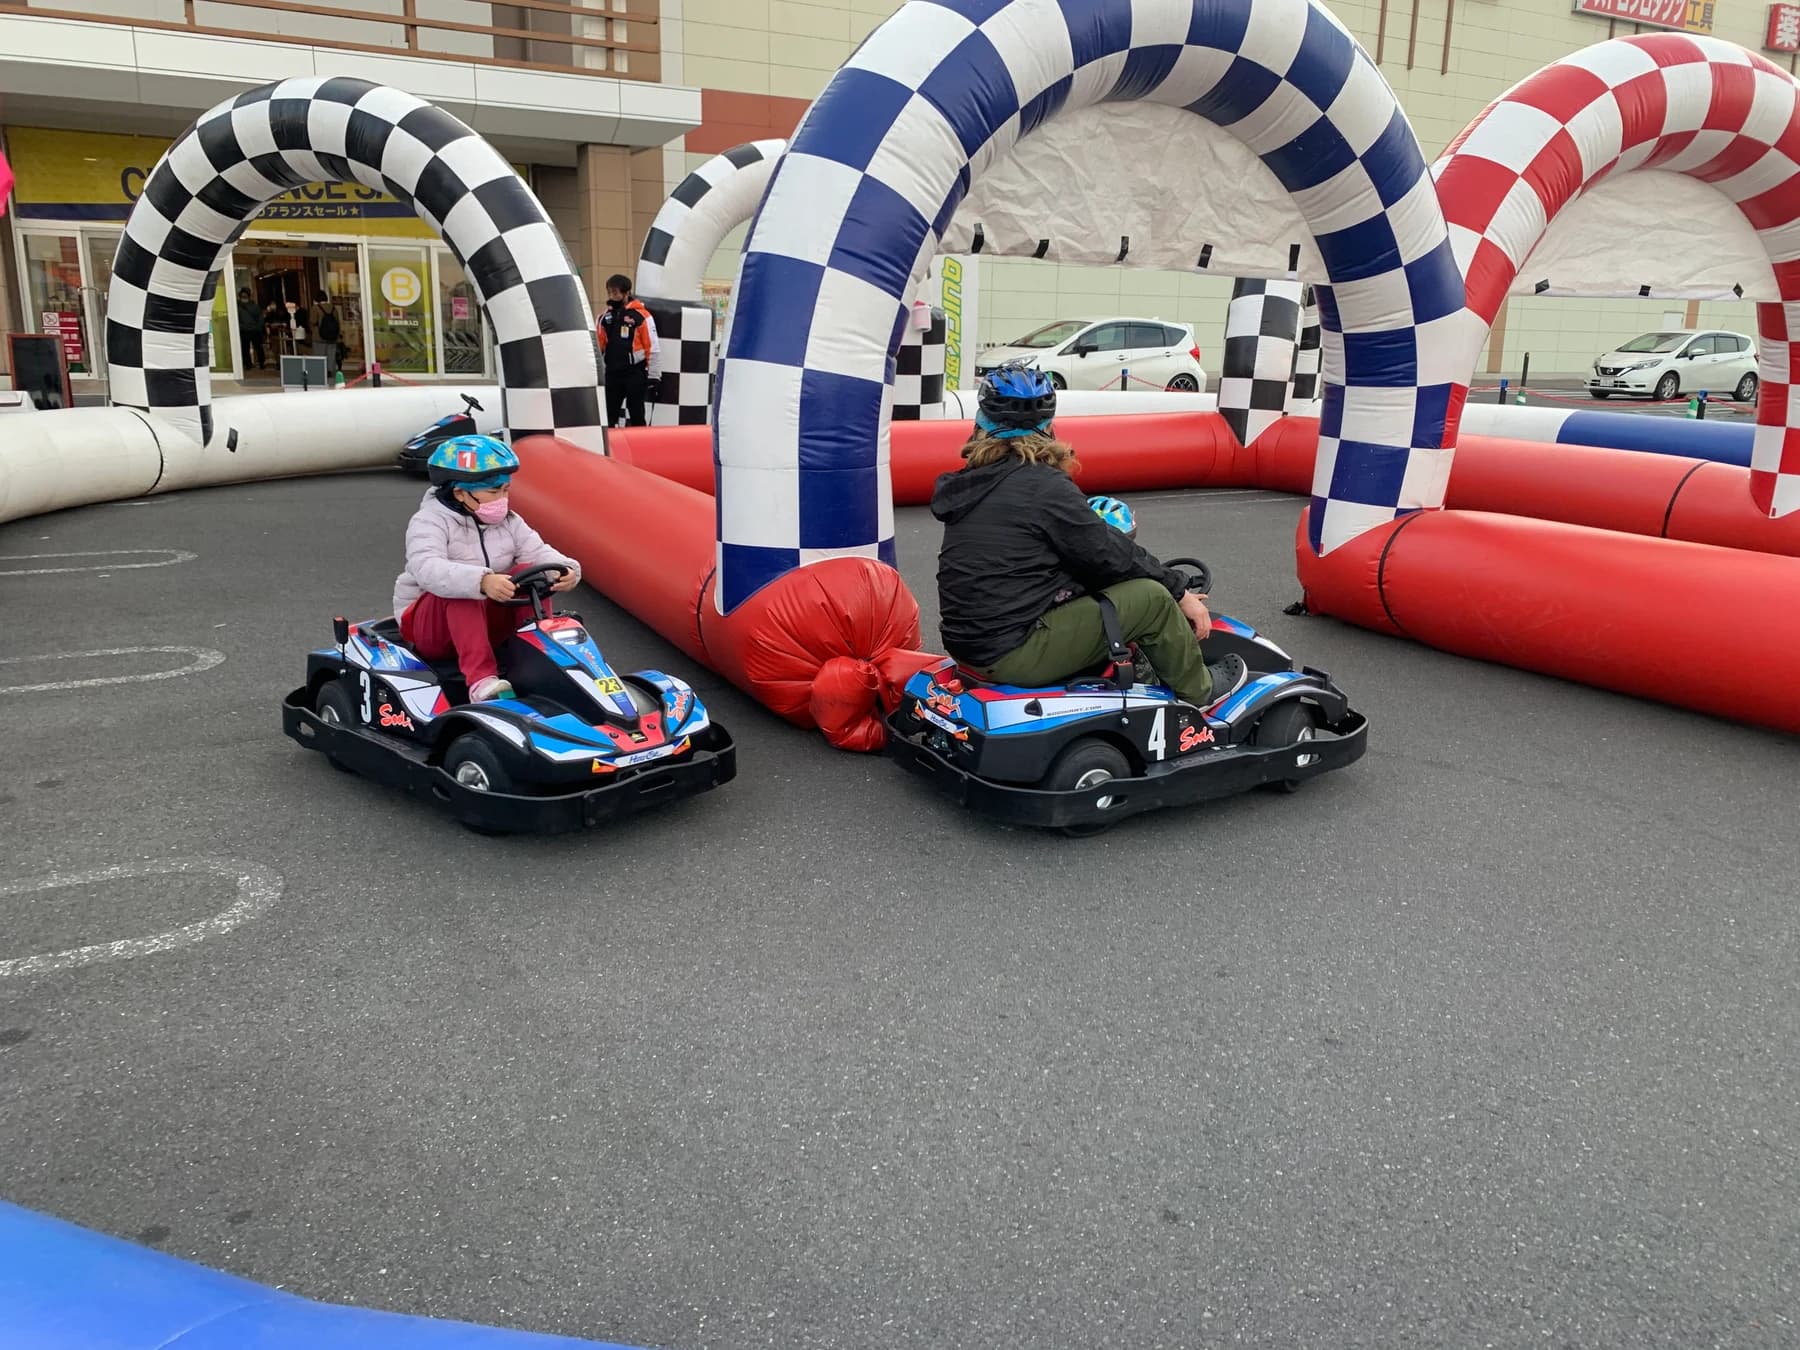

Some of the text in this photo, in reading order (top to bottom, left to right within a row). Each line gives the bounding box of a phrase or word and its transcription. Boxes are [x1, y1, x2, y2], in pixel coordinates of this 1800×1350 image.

[388, 273, 414, 301] B
[359, 670, 372, 723] 3
[598, 677, 623, 693] 23
[378, 703, 415, 732] Sodi
[1147, 707, 1166, 761] 4
[1179, 725, 1215, 752] Sodi
